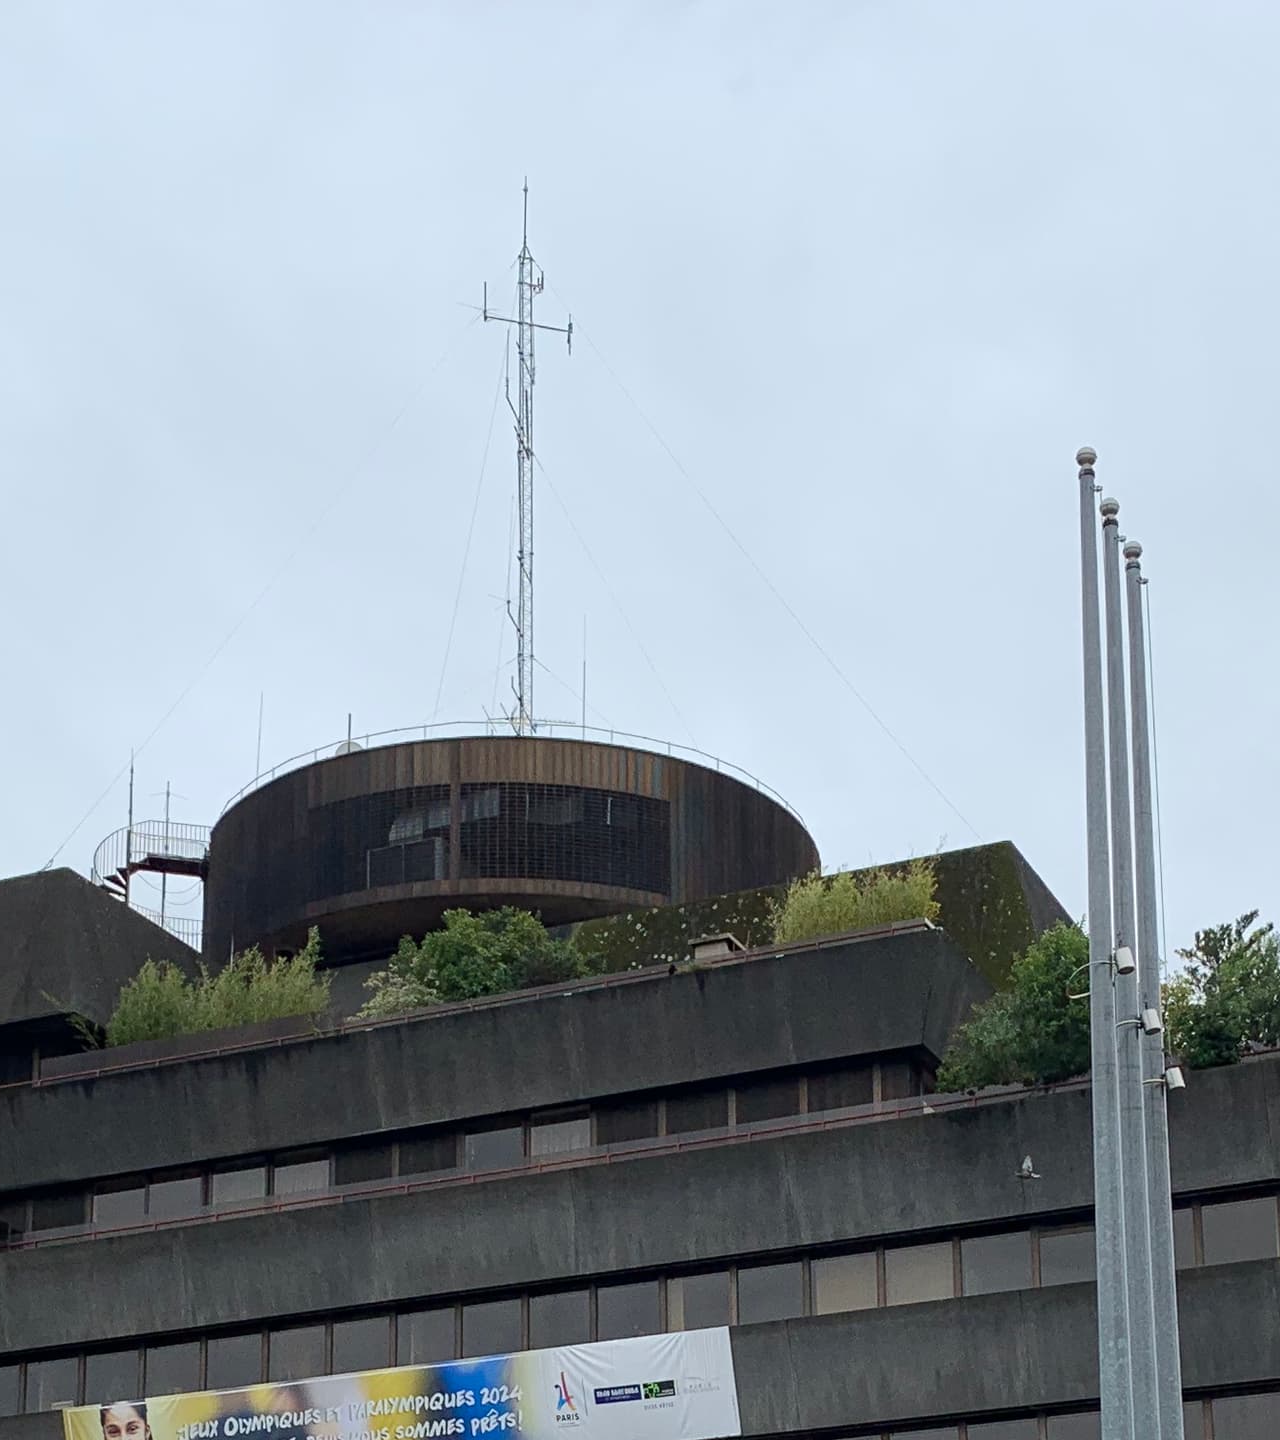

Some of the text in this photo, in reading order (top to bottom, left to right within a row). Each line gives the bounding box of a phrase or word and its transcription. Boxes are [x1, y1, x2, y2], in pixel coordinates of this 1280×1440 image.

[224, 1408, 321, 1436] OLYMPIQUES
[325, 1407, 342, 1422] ET
[350, 1389, 475, 1421] PARALYMPIQUES
[480, 1384, 522, 1405] 2024
[395, 1418, 465, 1439] SOMMES
[471, 1408, 522, 1437] PRÊTS!
[556, 1413, 580, 1422] PARIS
